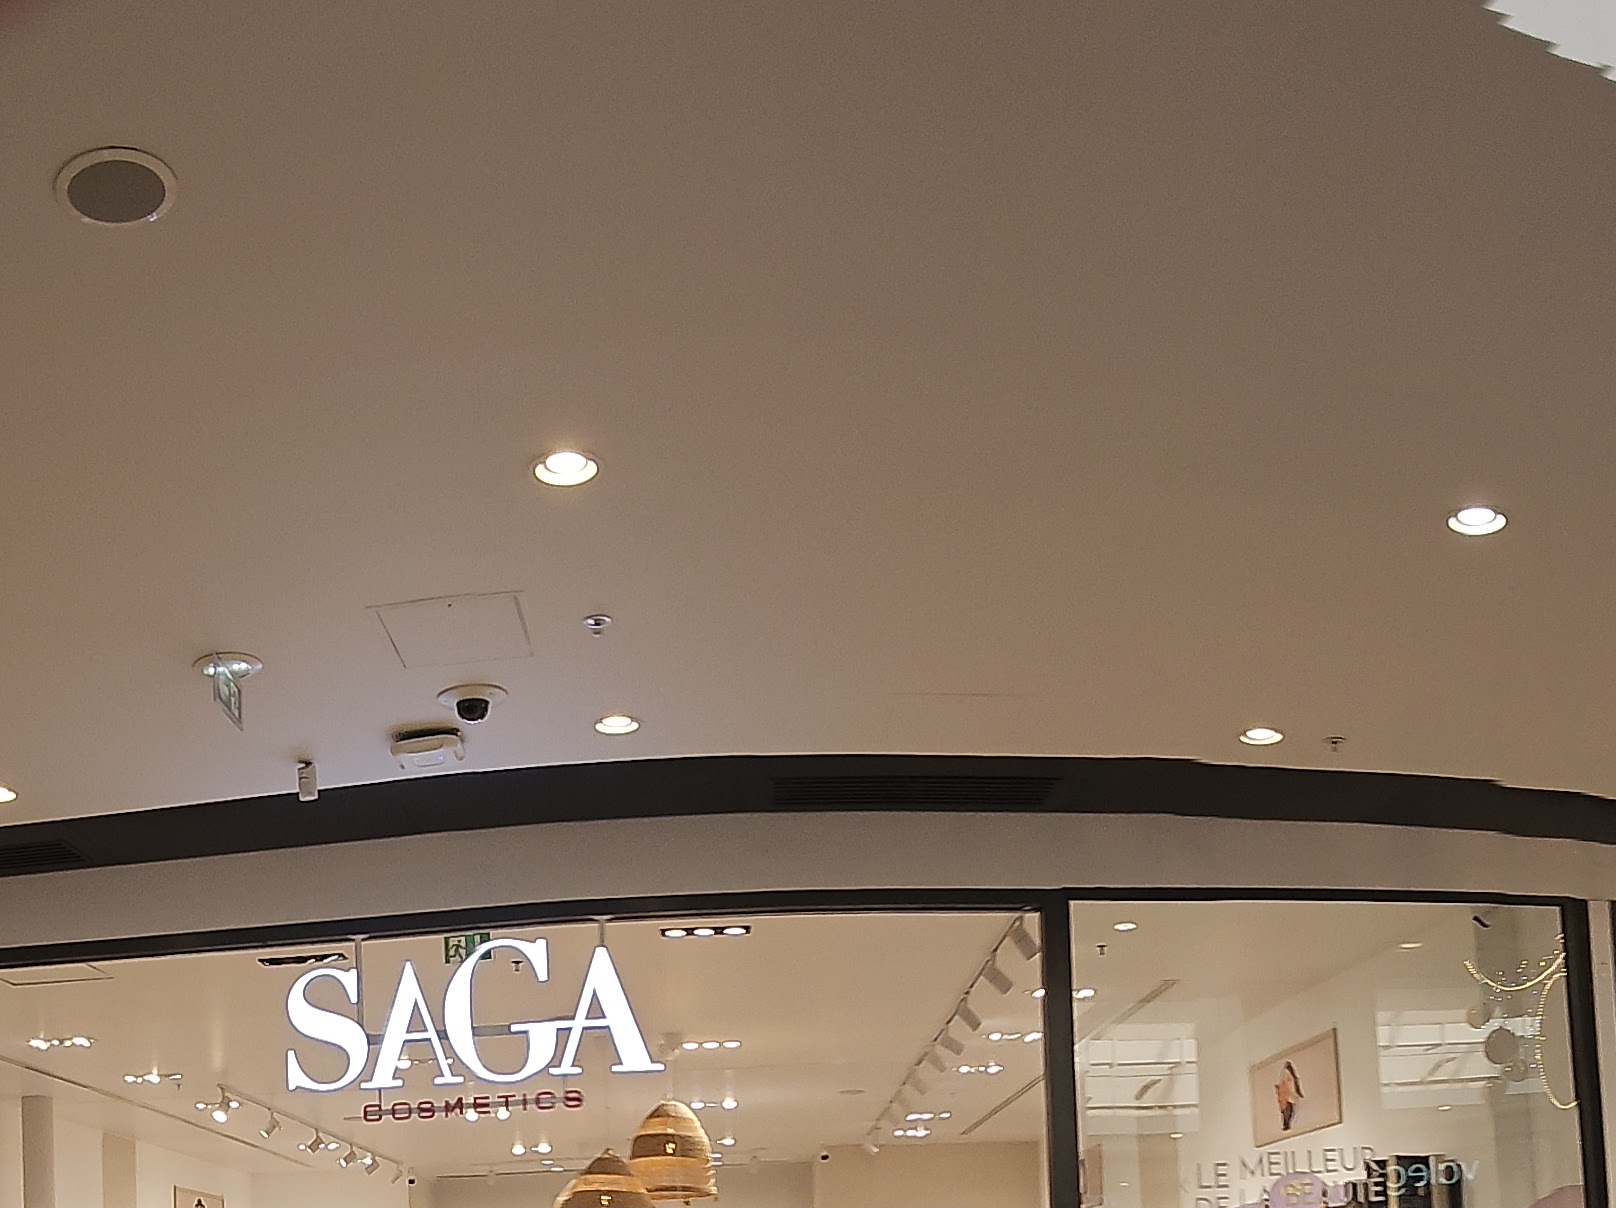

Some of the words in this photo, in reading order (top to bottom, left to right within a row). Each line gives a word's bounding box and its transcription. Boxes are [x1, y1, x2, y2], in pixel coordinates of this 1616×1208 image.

[286, 937, 666, 1093] SAGA
[362, 1089, 585, 1123] COSMETICS
[1194, 1160, 1230, 1190] LE
